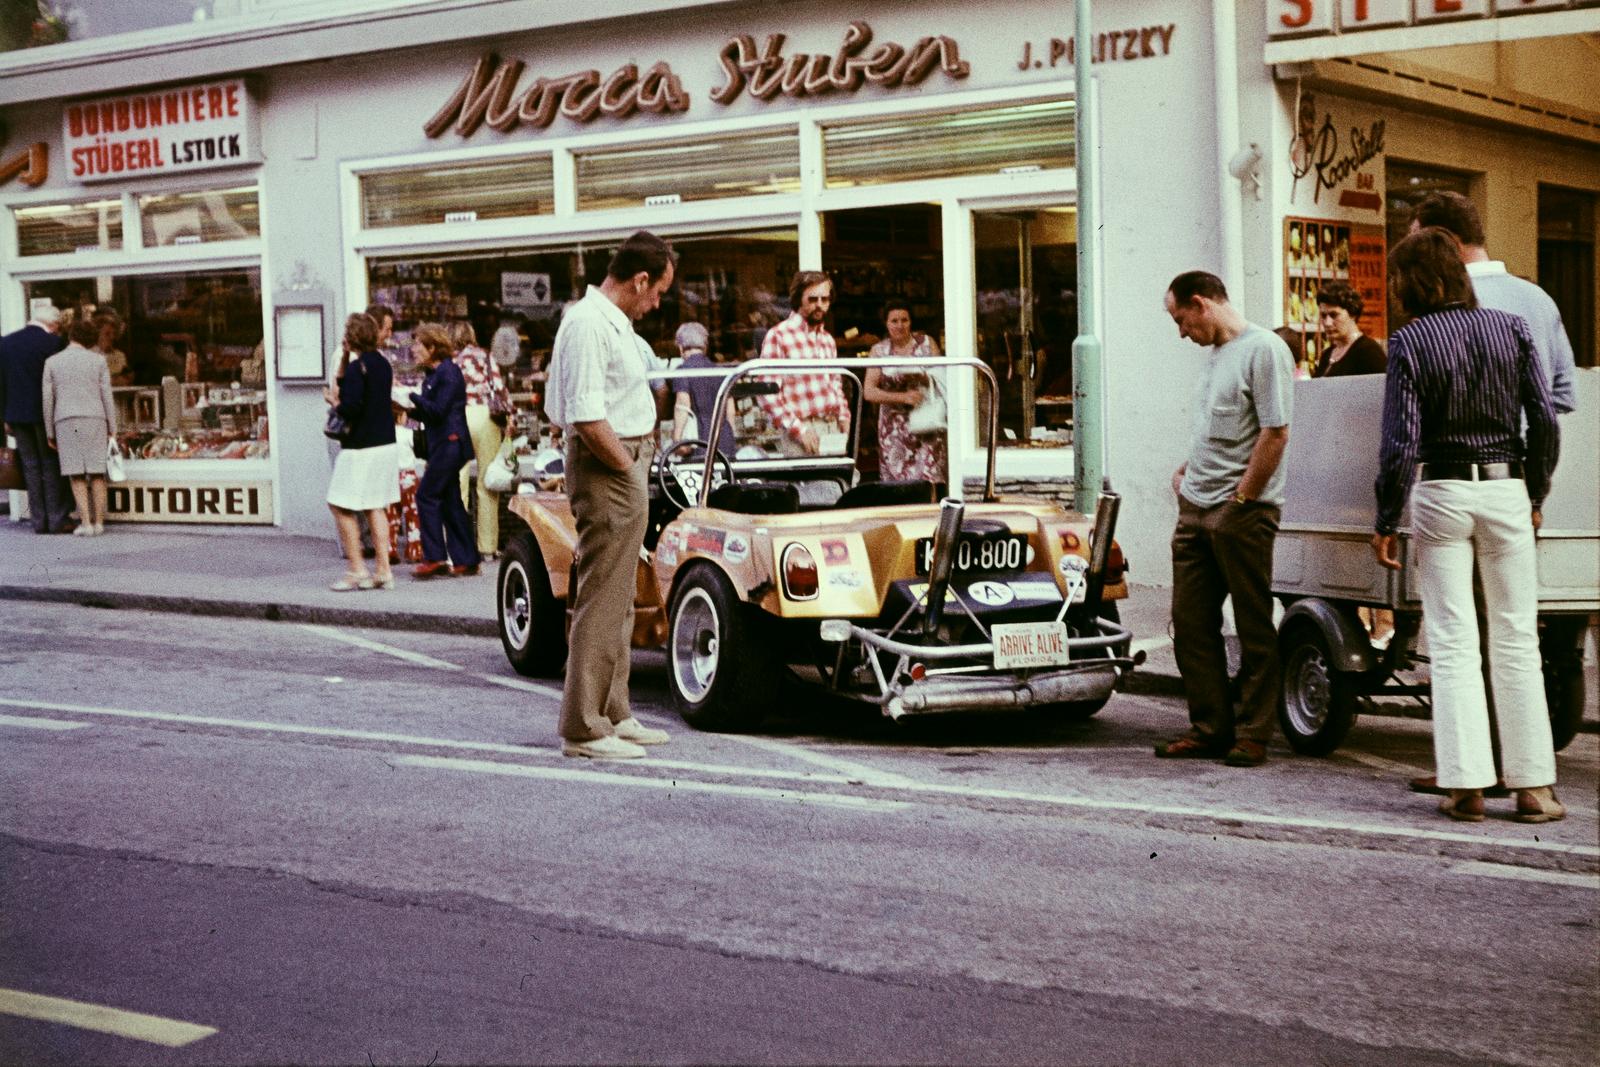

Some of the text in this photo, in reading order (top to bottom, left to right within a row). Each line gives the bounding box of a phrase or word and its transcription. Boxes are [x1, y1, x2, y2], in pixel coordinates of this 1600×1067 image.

[423, 20, 970, 138] Mocca Stuben
[68, 85, 239, 138] BONBONNIERE
[71, 136, 164, 176] STÜBERL
[984, 584, 1003, 600] A
[1000, 632, 1063, 657] ARRIVE ALIVE
